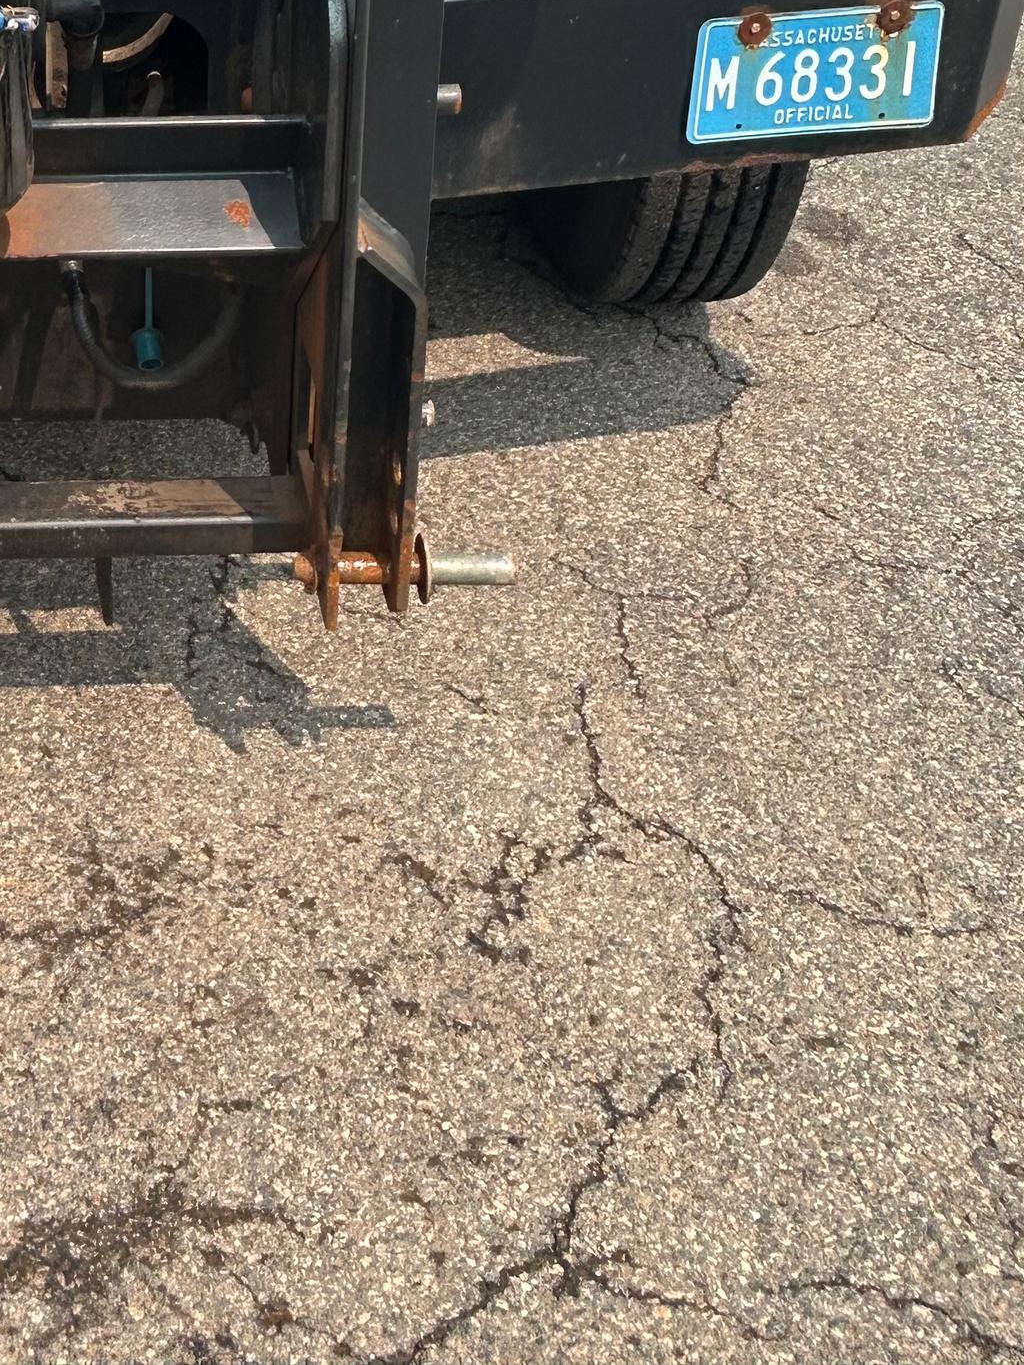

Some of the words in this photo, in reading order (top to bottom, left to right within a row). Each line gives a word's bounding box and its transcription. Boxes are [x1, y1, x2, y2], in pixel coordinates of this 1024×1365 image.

[745, 23, 900, 50] ASSACHUSET
[705, 55, 740, 112] M
[754, 40, 916, 107] 68331
[773, 103, 854, 125] OFFICIAL
